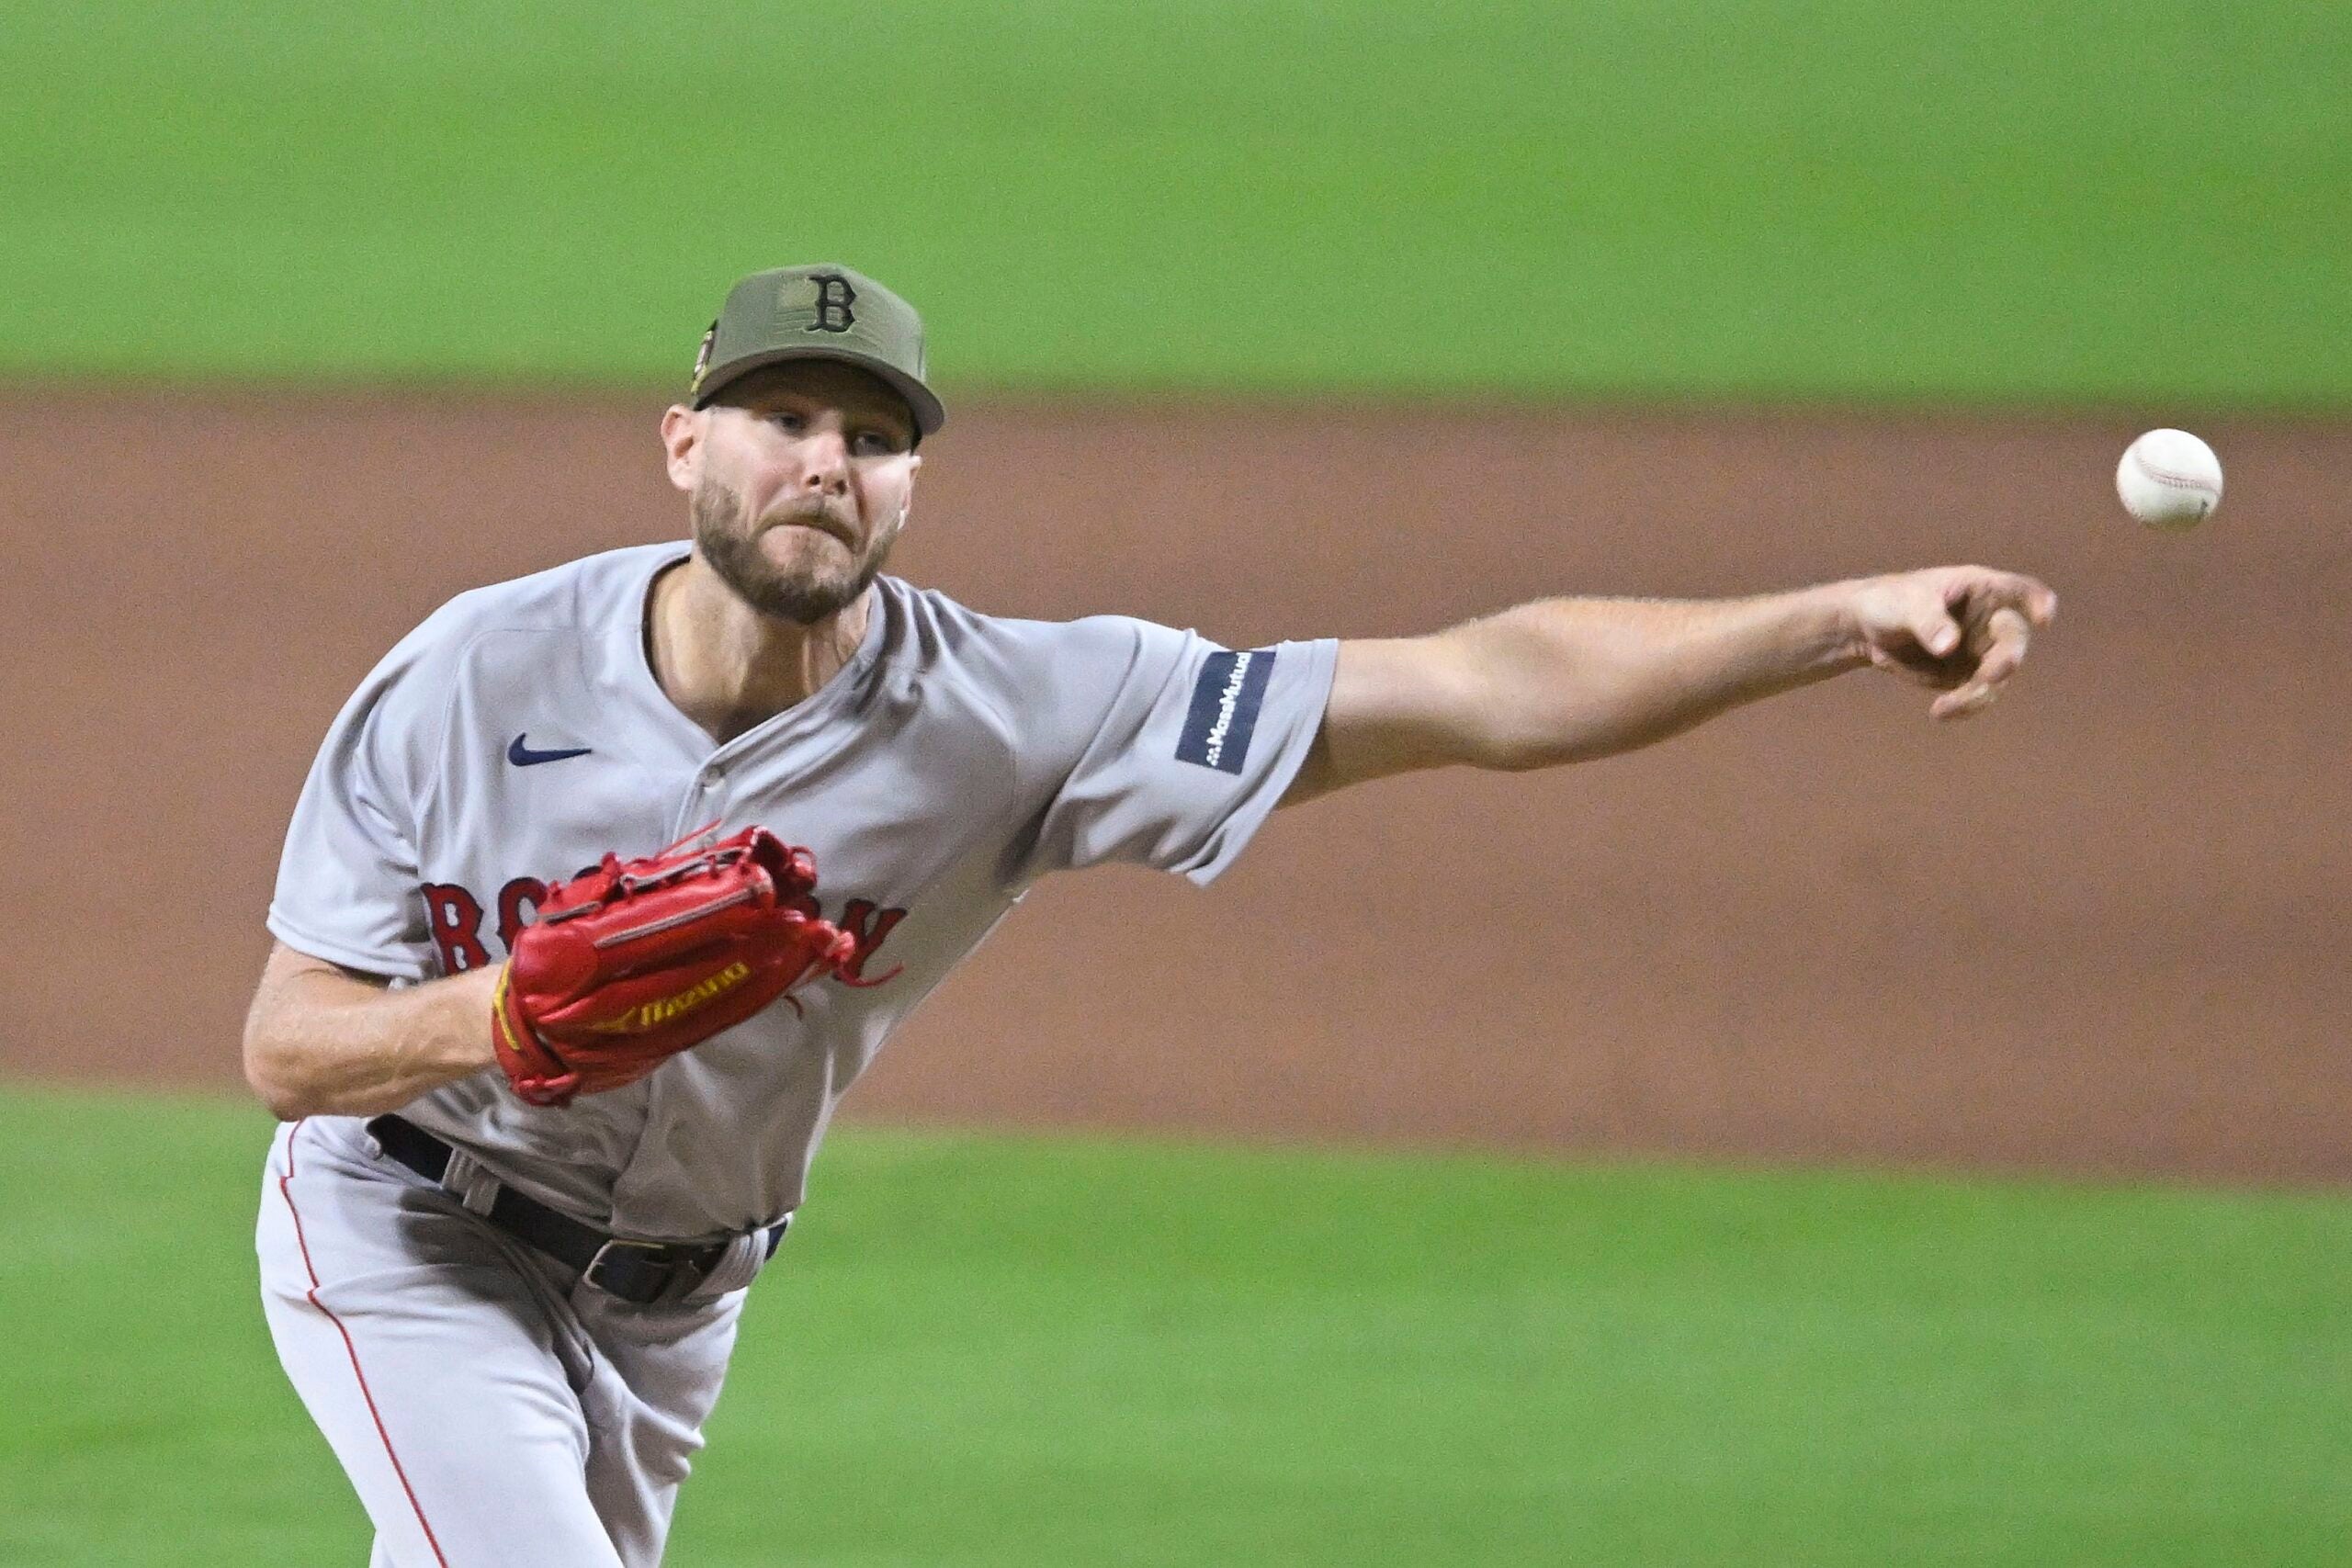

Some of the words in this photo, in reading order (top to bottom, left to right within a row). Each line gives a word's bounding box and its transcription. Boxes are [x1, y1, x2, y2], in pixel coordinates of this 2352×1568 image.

[805, 274, 856, 332] B
[1205, 651, 1252, 746] MassMutual
[420, 866, 908, 986] BON
